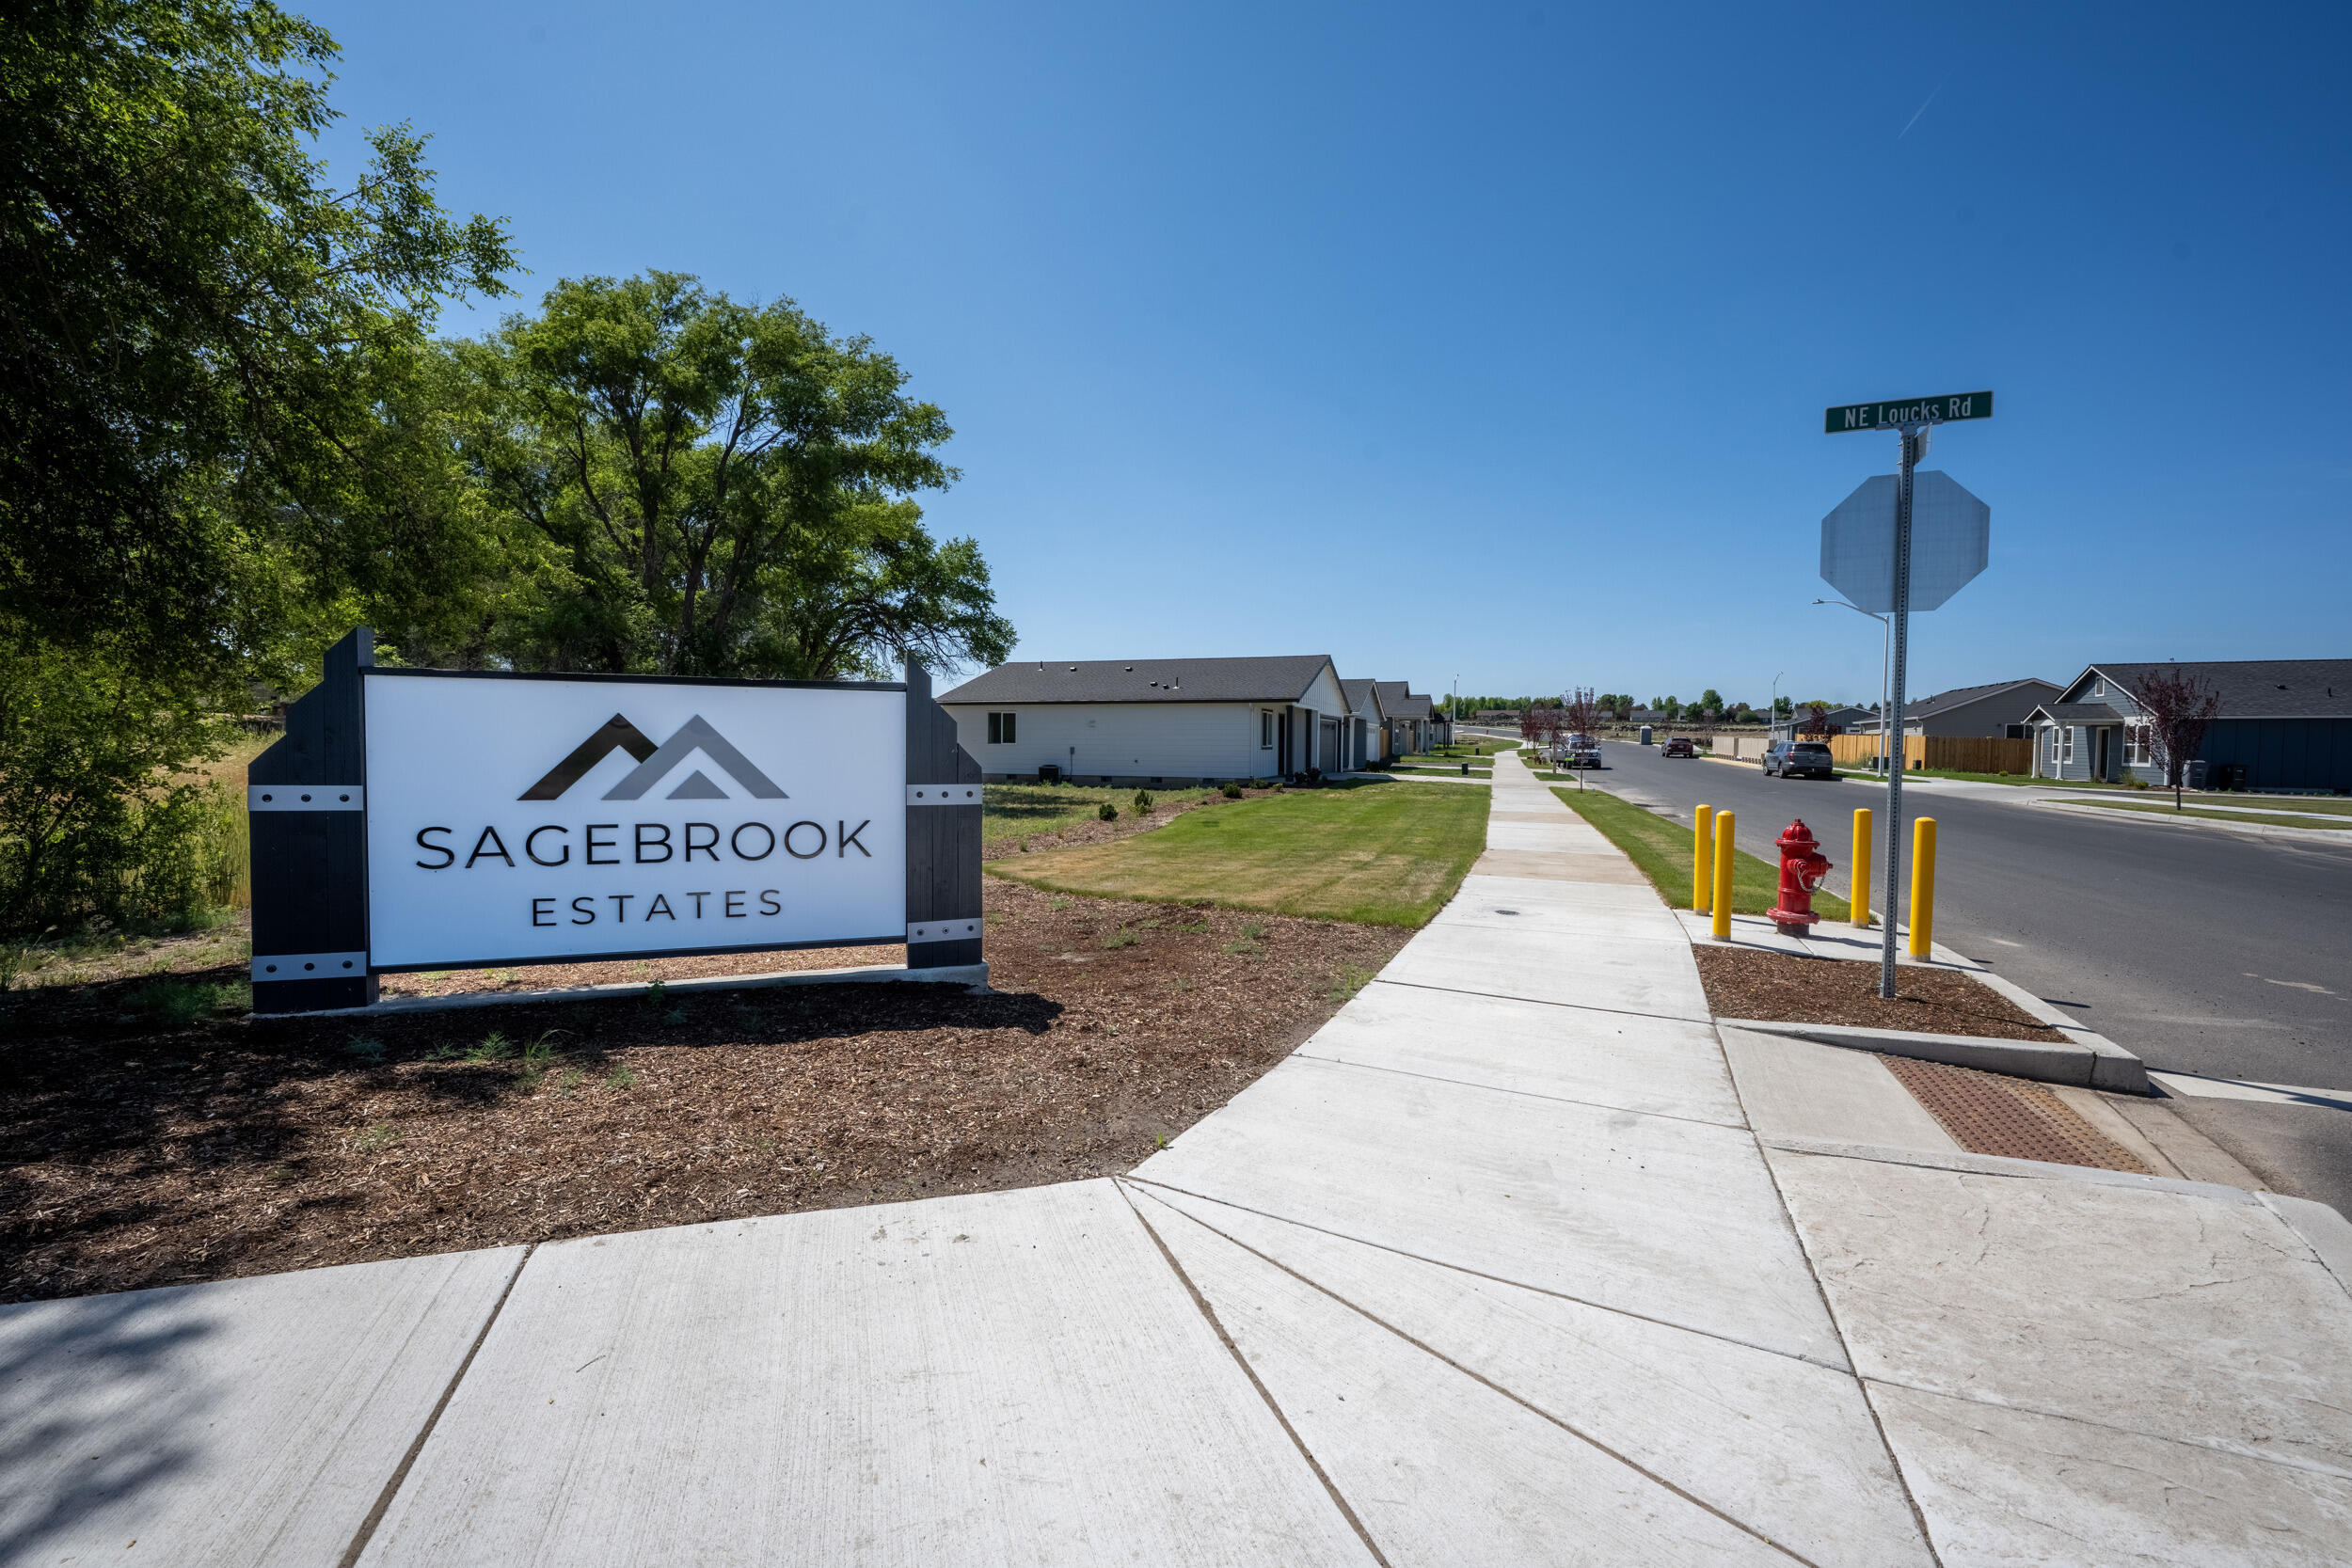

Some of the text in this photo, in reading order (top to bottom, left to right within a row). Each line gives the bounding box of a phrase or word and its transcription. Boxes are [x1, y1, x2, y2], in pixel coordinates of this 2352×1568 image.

[1845, 397, 1972, 428] NE Loucks Rd
[415, 819, 872, 870] SAGEBROOK
[532, 889, 782, 927] ESTATES
